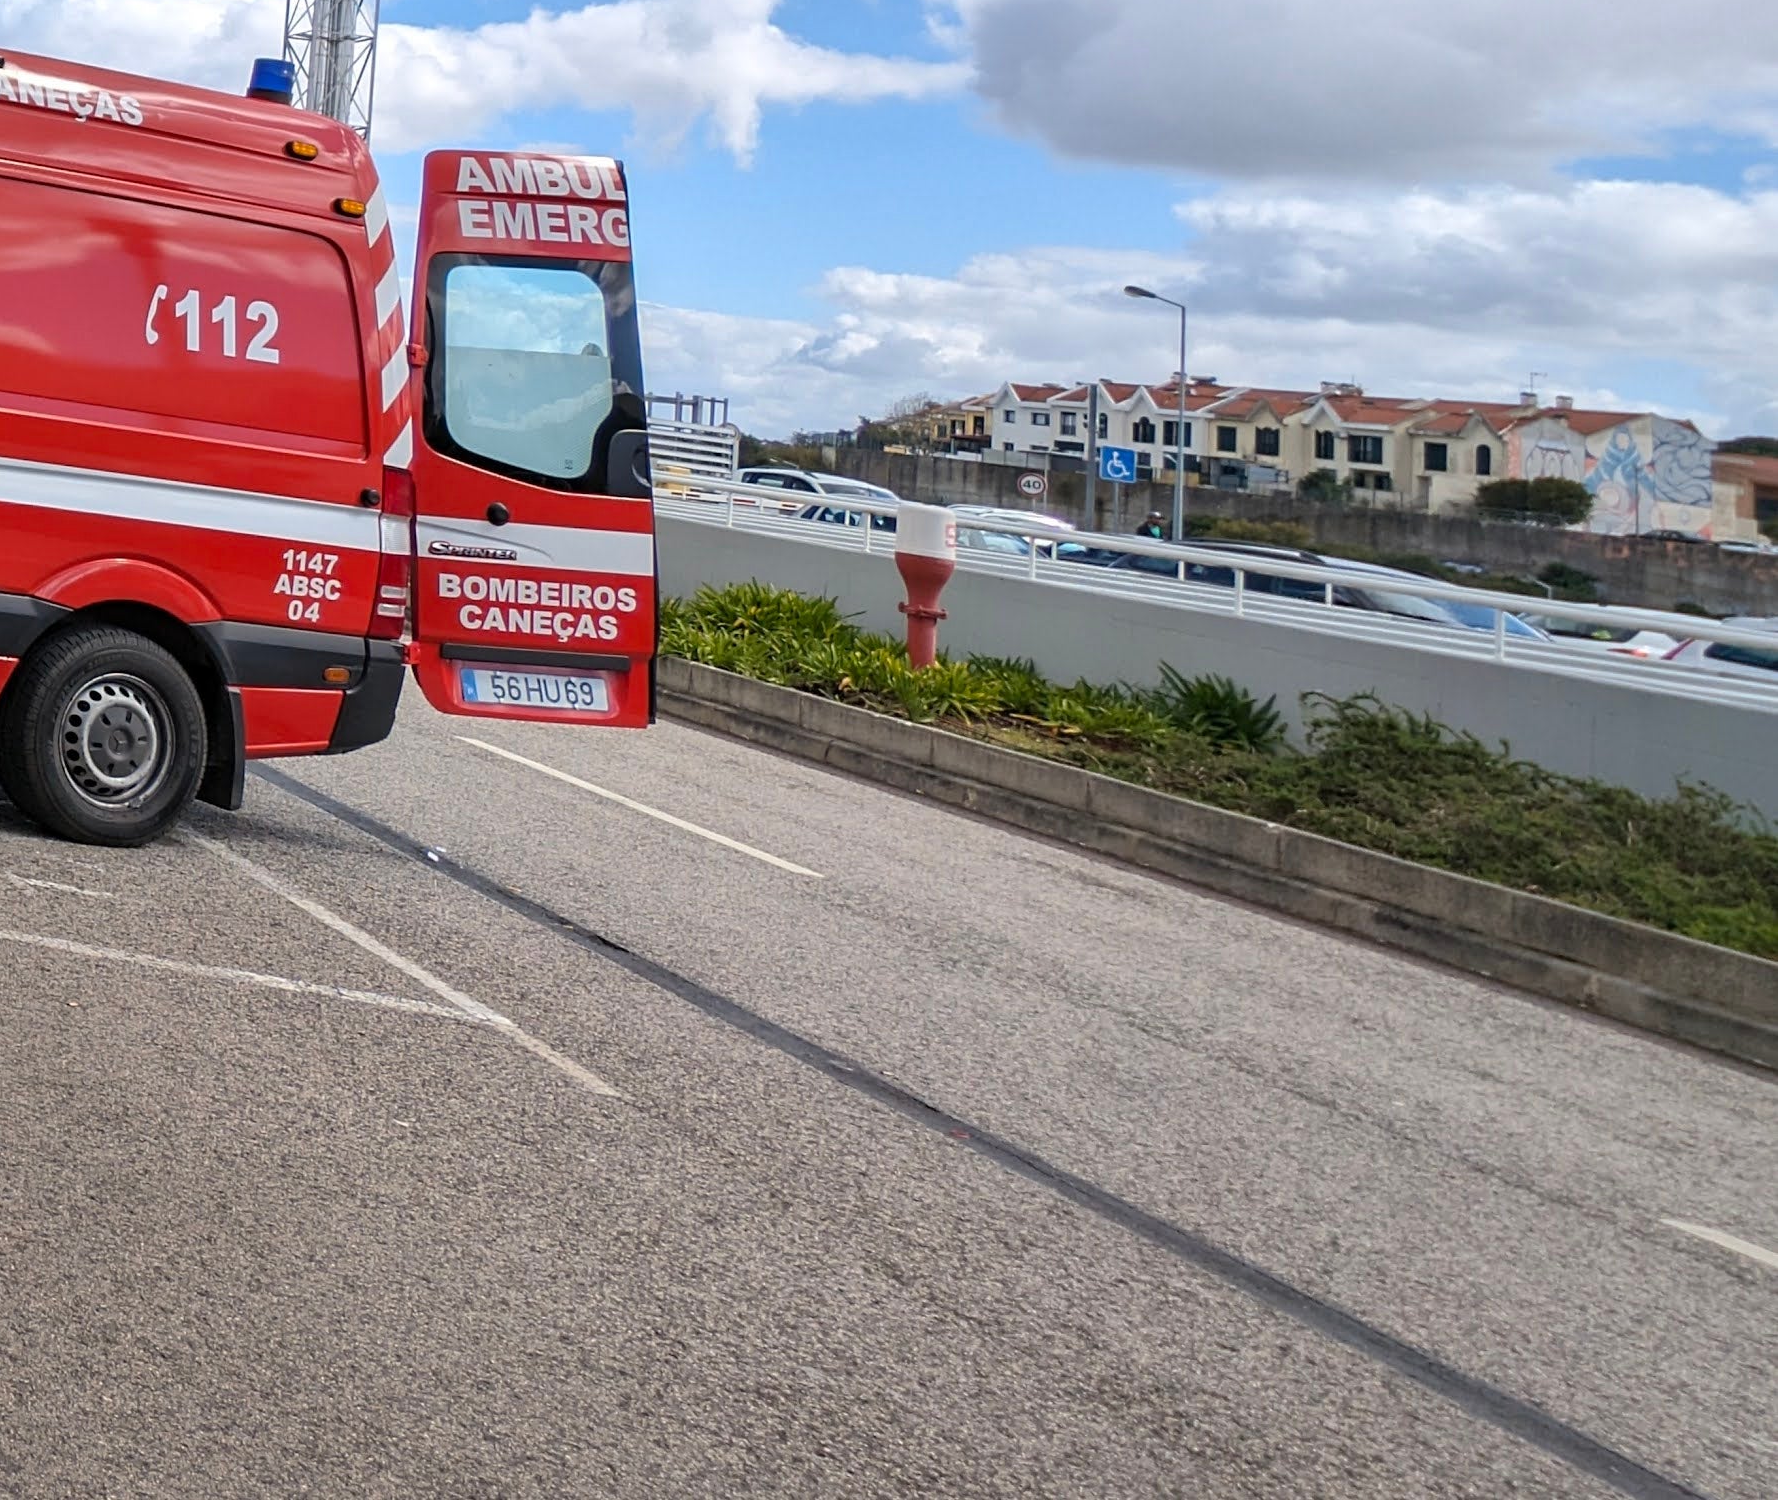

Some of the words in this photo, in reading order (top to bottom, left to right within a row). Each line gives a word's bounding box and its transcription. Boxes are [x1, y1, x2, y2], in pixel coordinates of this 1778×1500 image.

[175, 290, 280, 364] 112
[1023, 479, 1041, 490] 40
[282, 549, 339, 575] 1147
[429, 540, 517, 561] SPRINTER
[273, 573, 342, 601] ABSC
[438, 573, 637, 613] BOMBEIROS
[287, 601, 321, 623] 04
[459, 604, 619, 643] CANEÇAS
